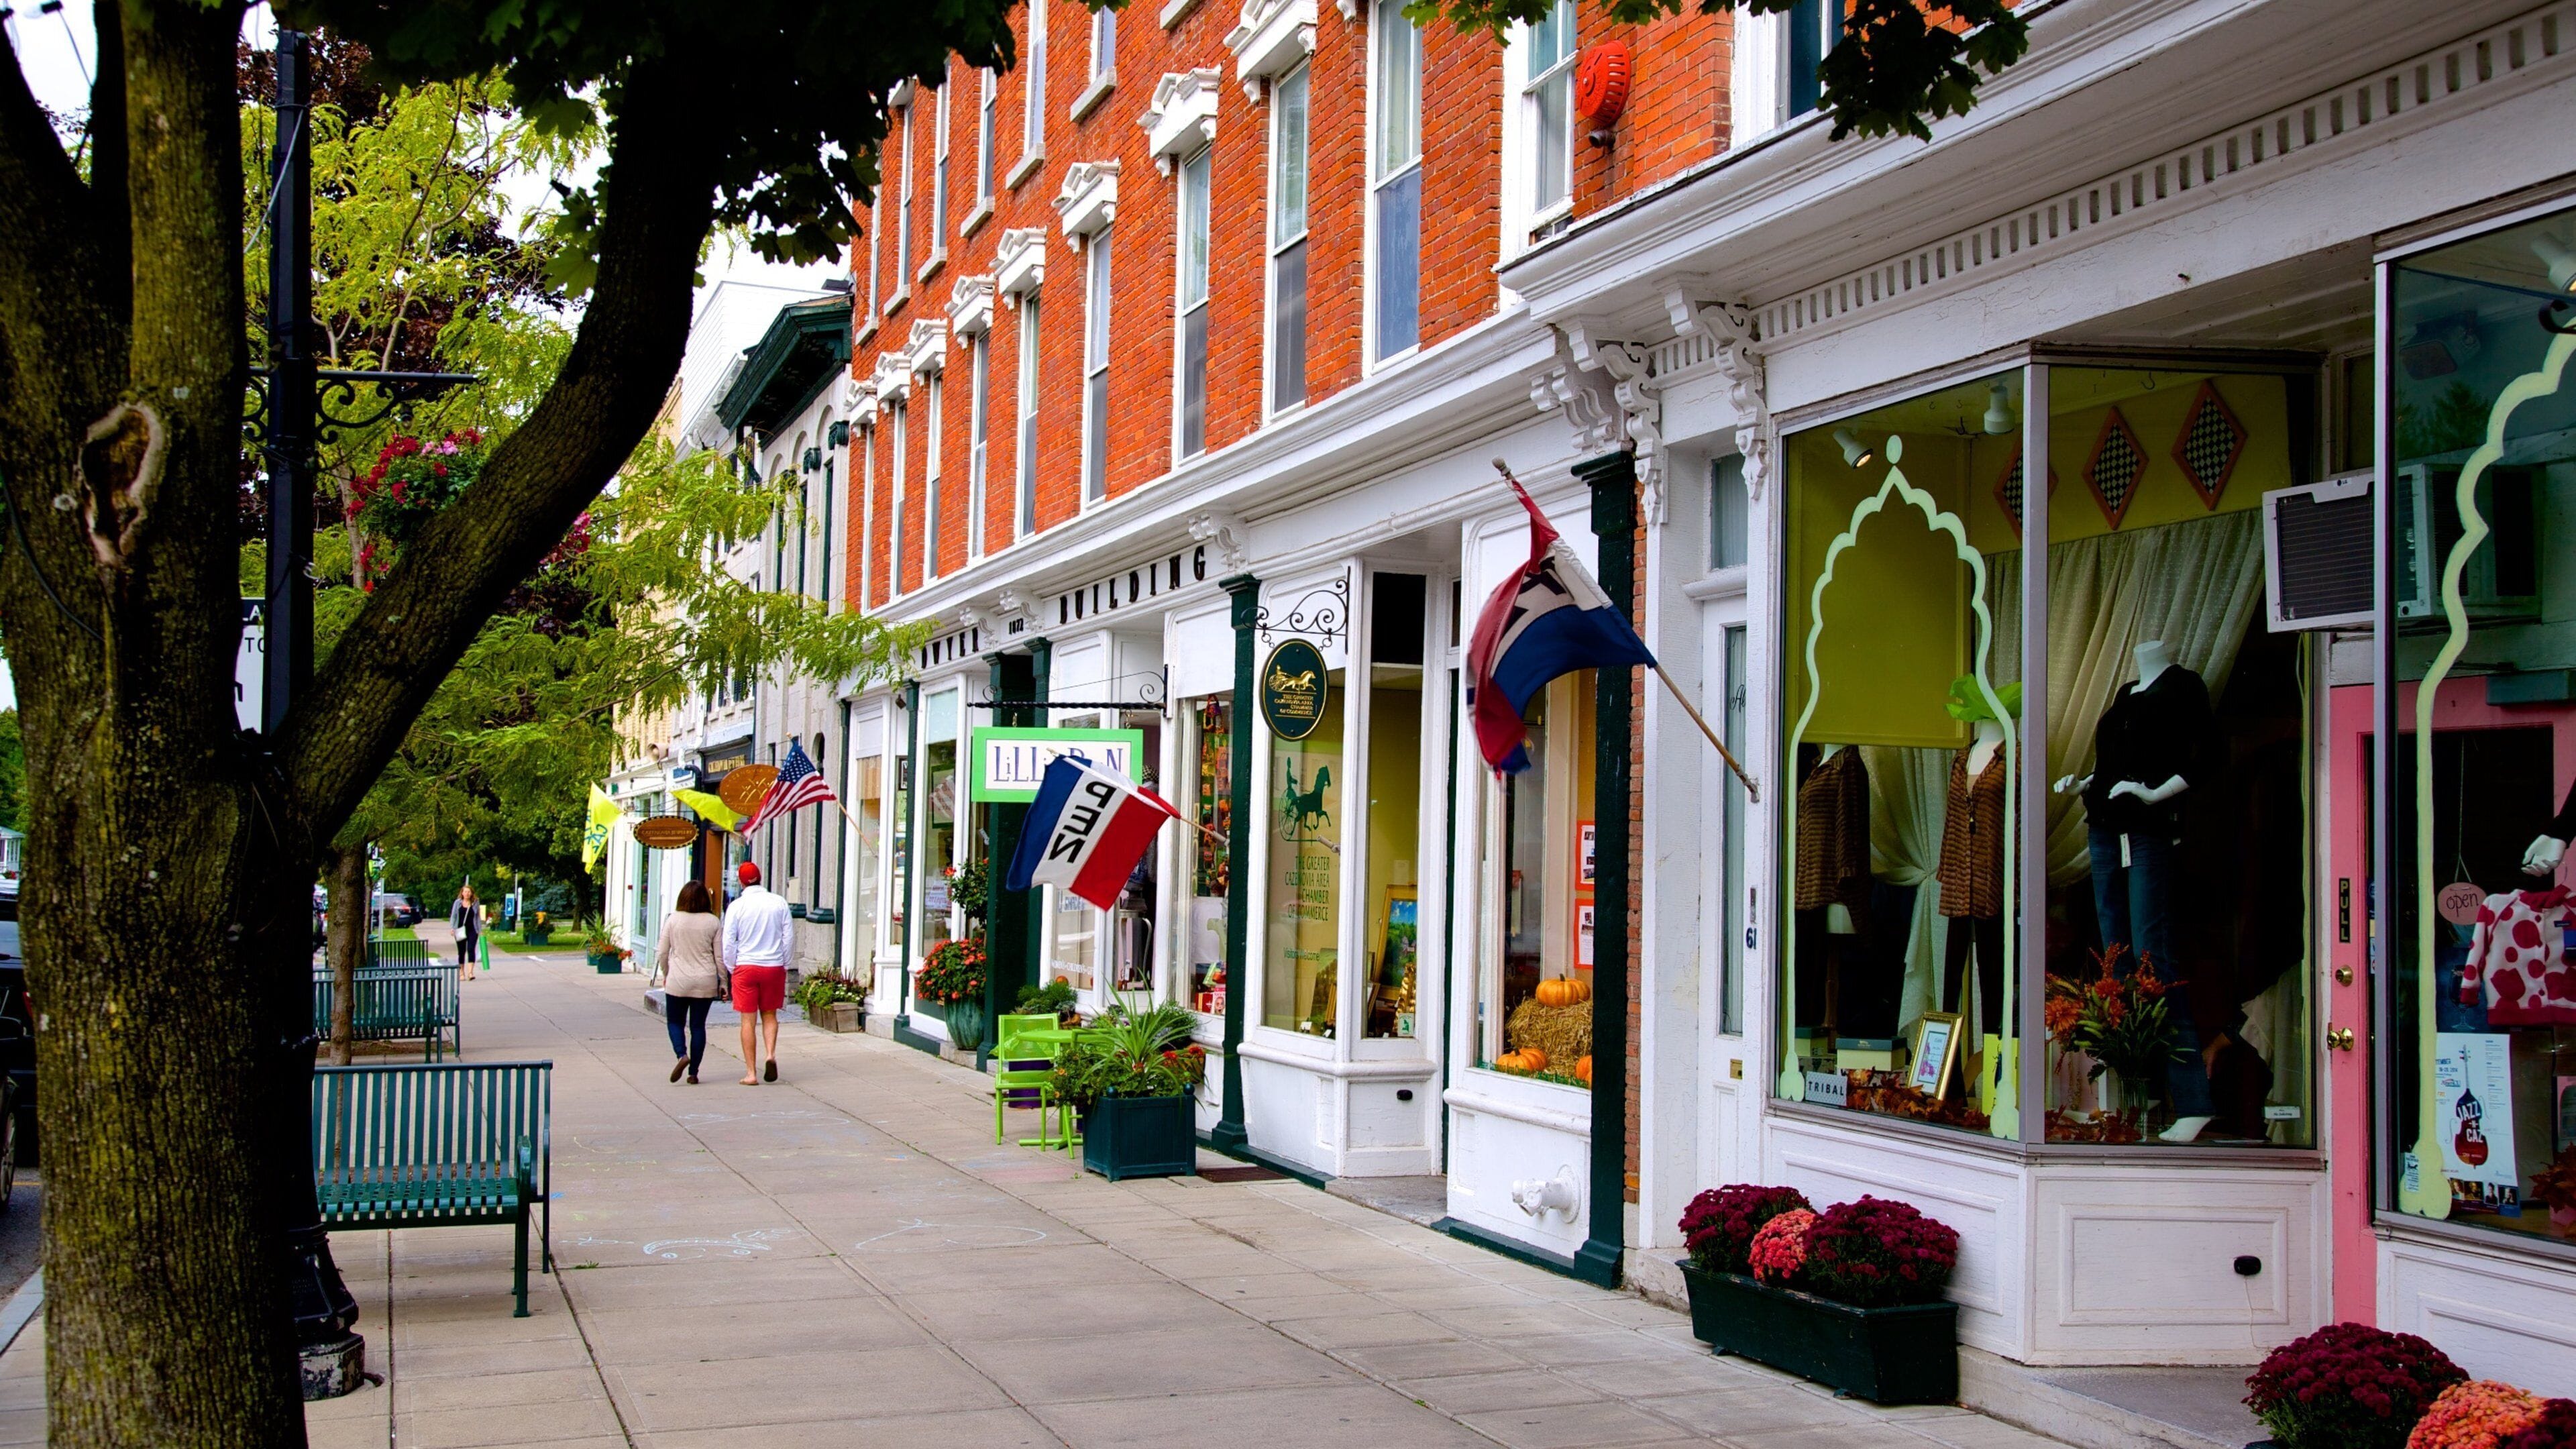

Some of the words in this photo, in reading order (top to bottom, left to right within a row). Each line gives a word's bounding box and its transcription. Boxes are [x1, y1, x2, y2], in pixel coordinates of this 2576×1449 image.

[1008, 618, 1024, 635] 1872
[1059, 545, 1206, 625] BUILDING
[1295, 856, 1305, 870] THE
[1306, 855, 1330, 871] GREATER
[1285, 871, 1314, 887] CAZENOVIA
[1316, 873, 1330, 888] AREA
[1301, 888, 1330, 904] CHAMBER
[1287, 904, 1296, 919] OF
[1297, 905, 1329, 922] COMMERCE
[2340, 880, 2349, 941] PULL
[2446, 893, 2479, 918] open
[1746, 927, 1756, 950] 61
[1300, 949, 1320, 961] Welcome
[1808, 1081, 1844, 1096] TRIBAL
[2457, 1101, 2481, 1121] JAZZ
[2466, 1128, 2483, 1143] CAZ
